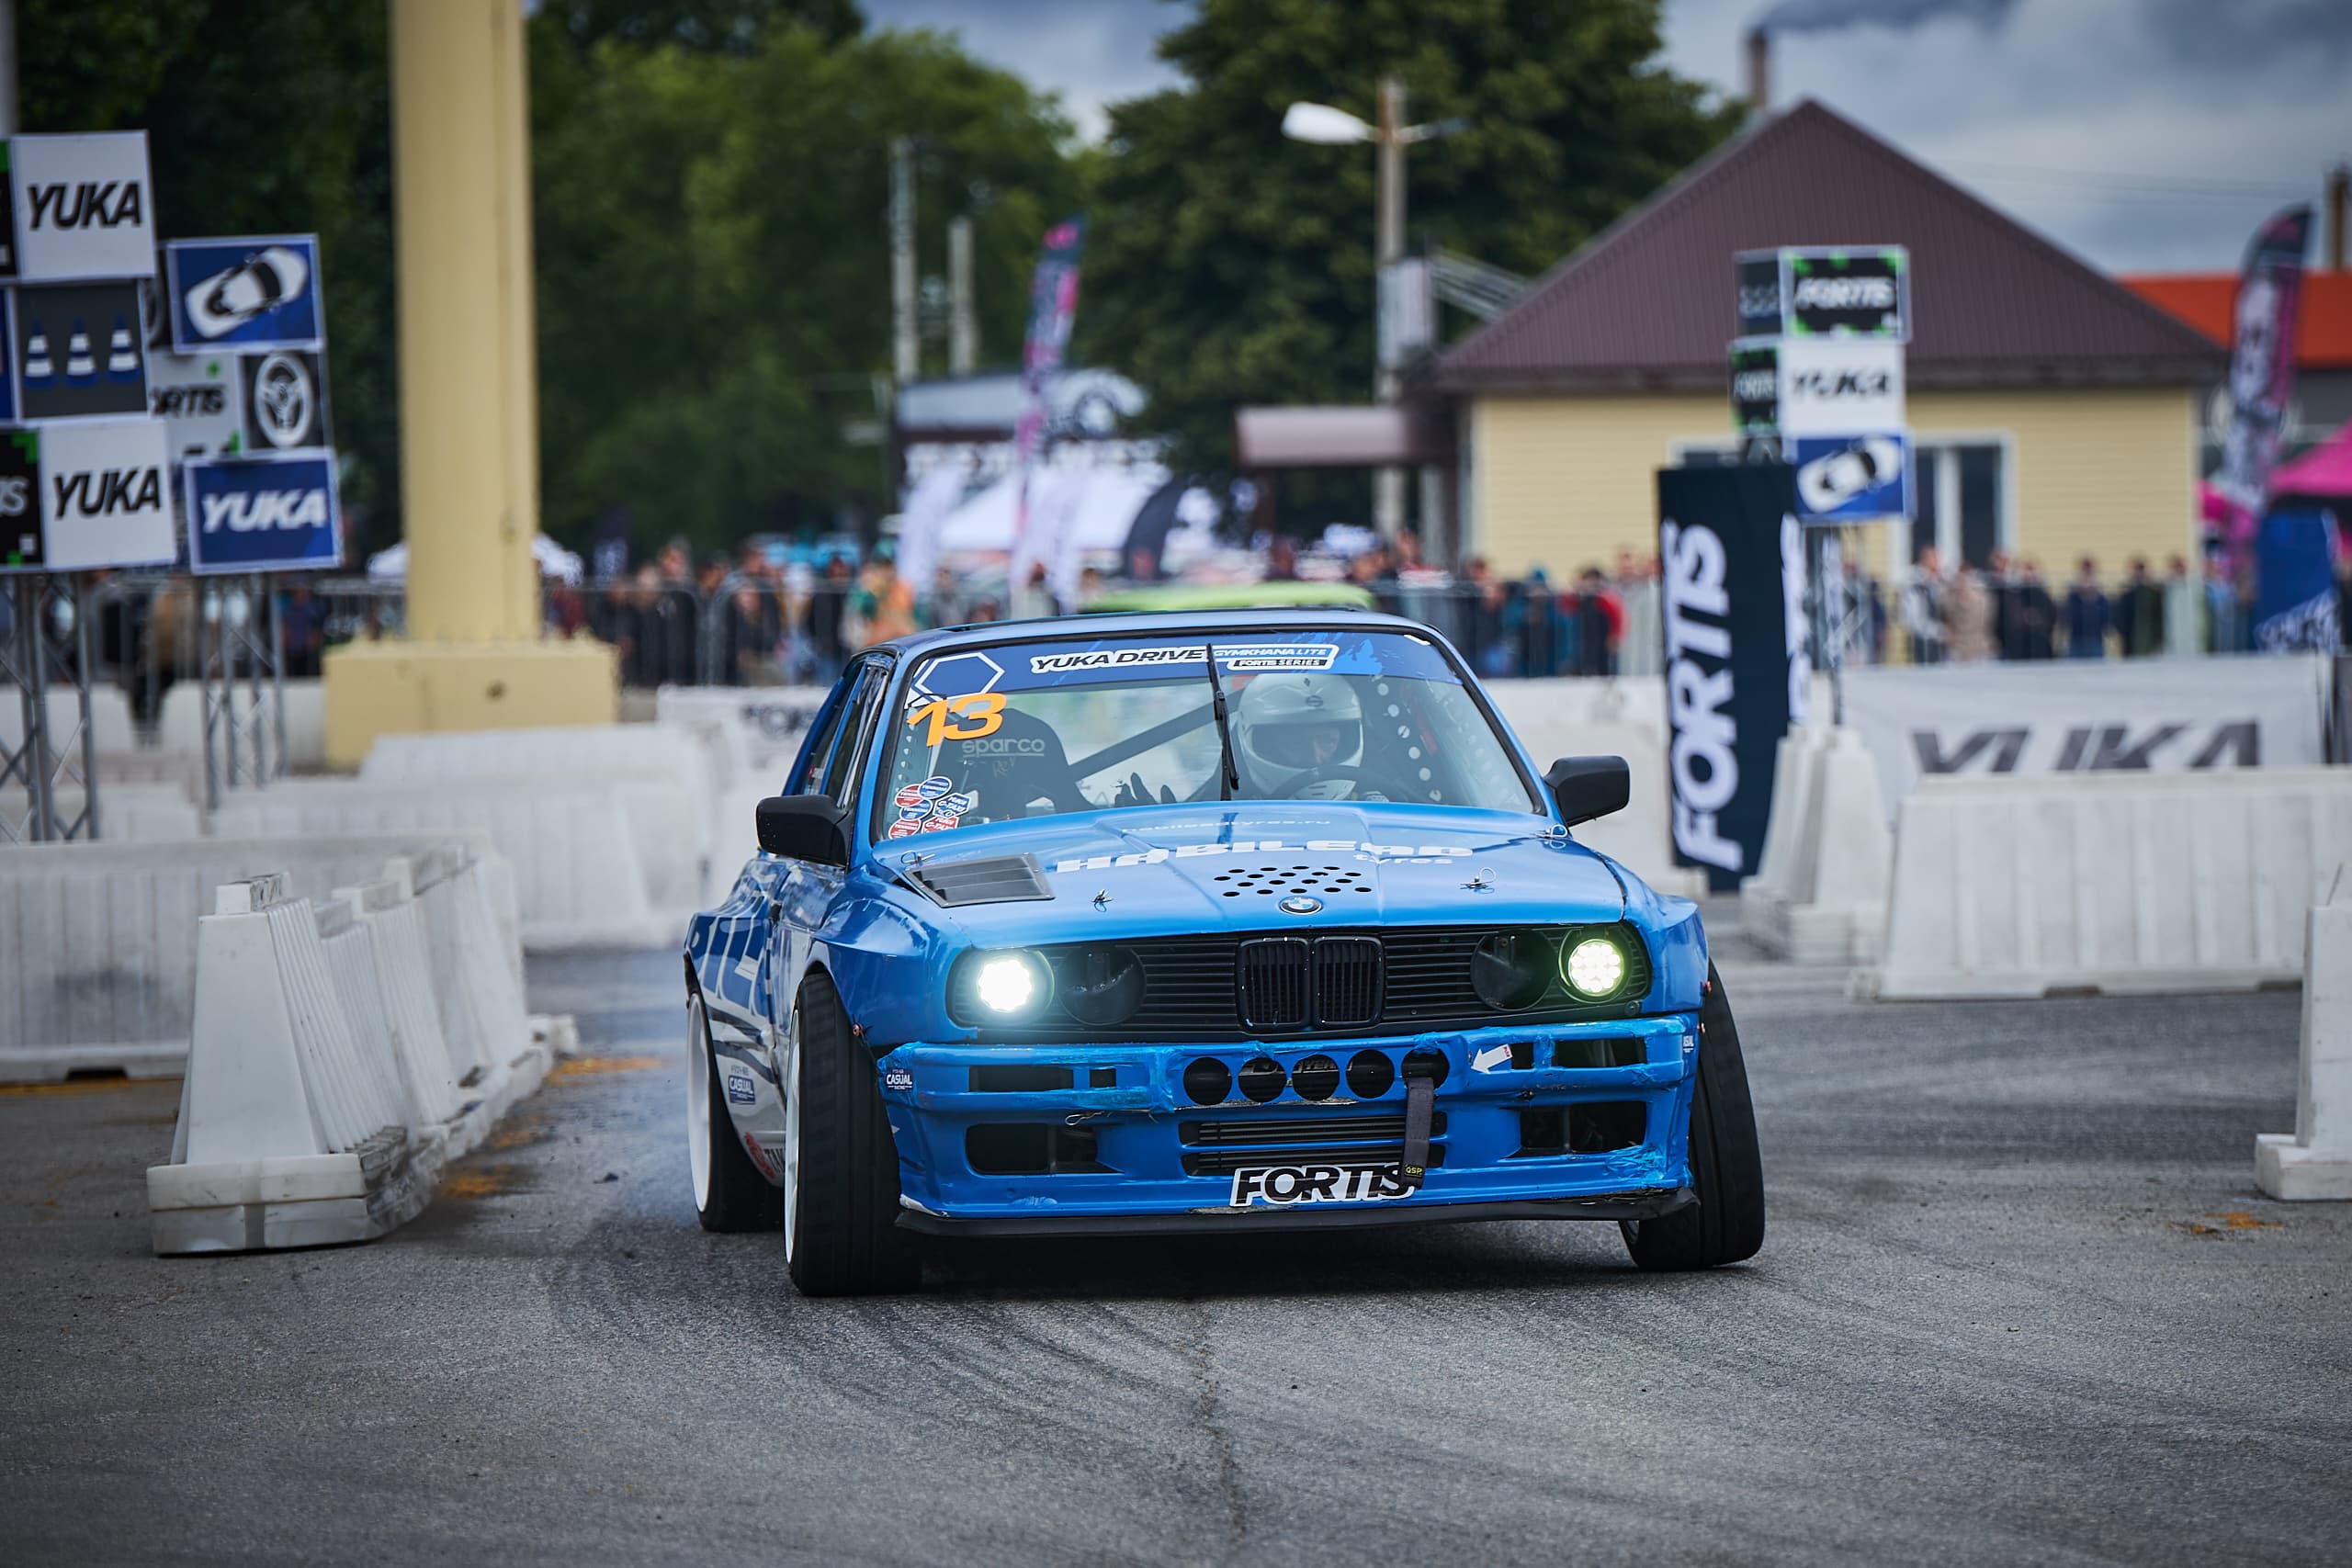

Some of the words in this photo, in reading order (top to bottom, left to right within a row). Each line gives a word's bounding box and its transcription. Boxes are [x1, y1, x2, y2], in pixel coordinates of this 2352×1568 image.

[28, 182, 141, 231] YUKA
[53, 466, 162, 520] YUKA
[201, 488, 327, 533] YUKA
[1035, 653, 1110, 670] YUKA
[1115, 649, 1206, 663] DRIVE
[1215, 649, 1295, 657] GYMKHANA
[1296, 648, 1327, 656] LITE
[1278, 659, 1321, 667] SERIES
[1659, 517, 1744, 873] FORTIS
[906, 692, 1008, 748] 13
[962, 738, 1046, 758] sparco
[1057, 840, 1474, 874] HABILEAD
[1406, 1166, 1423, 1175] QSP
